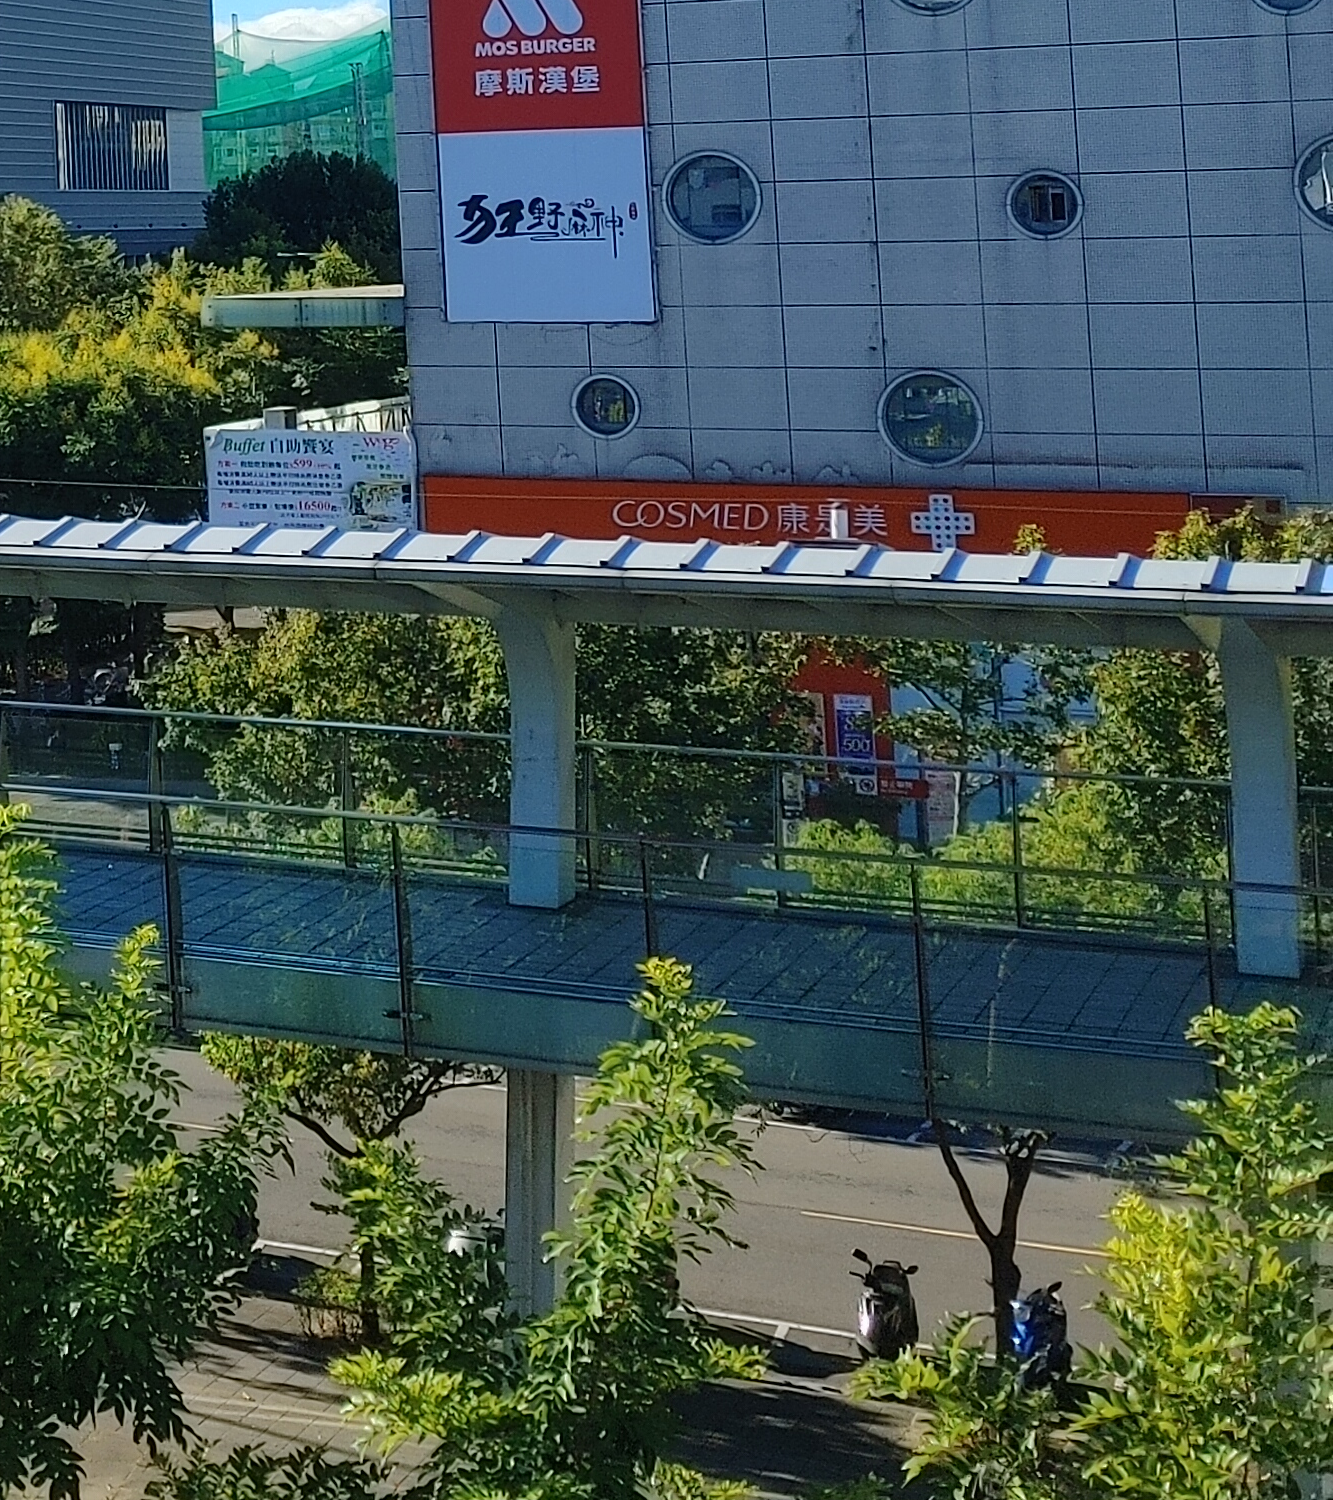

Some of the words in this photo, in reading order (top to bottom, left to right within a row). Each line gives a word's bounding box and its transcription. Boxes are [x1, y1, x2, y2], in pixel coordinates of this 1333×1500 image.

[475, 40, 518, 57] MOS
[520, 37, 596, 55] BURGER
[475, 65, 600, 97] 摩斯漢堡
[223, 438, 265, 456] Buffet
[612, 500, 769, 531] COSMED
